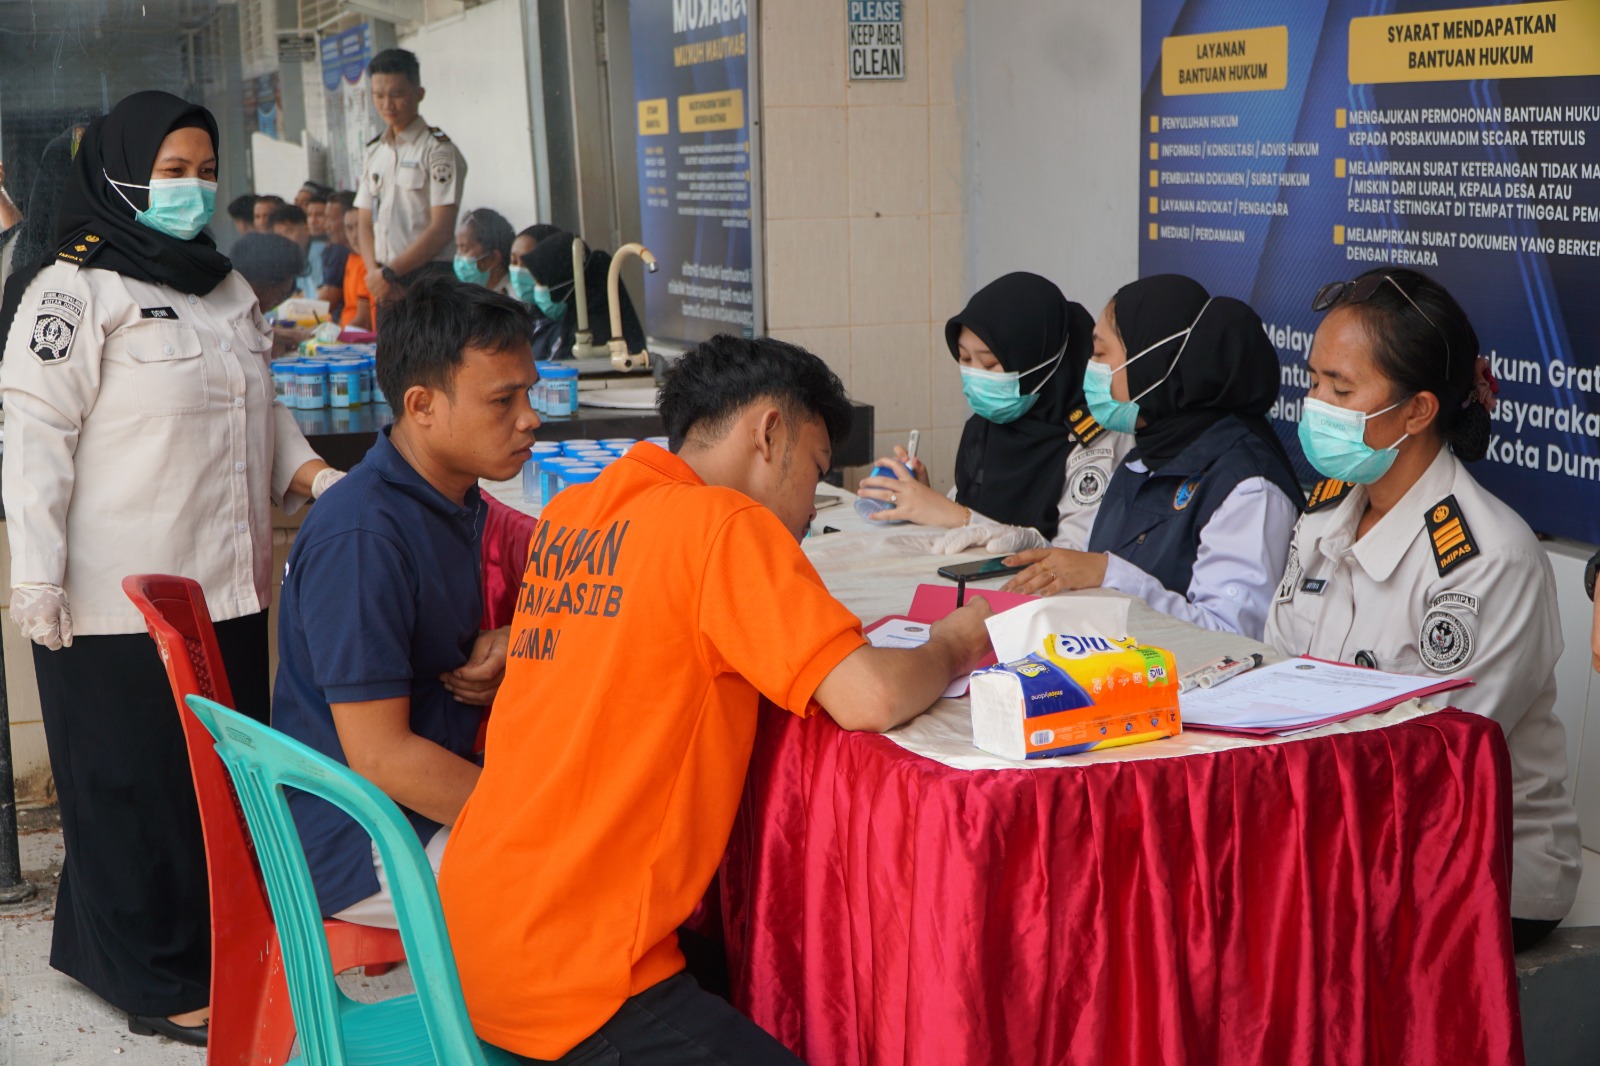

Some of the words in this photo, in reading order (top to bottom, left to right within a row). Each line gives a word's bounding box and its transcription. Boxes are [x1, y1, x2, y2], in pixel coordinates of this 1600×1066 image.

[850, 1, 901, 21] PLEASE
[850, 24, 875, 46] KEEP
[877, 22, 902, 45] AREA
[1387, 22, 1440, 43] SYARAT
[1443, 13, 1557, 40] MENDAPATKAN
[1196, 40, 1246, 59] LAYANAN
[1408, 48, 1476, 69] BANTUAN
[1479, 45, 1534, 66] HUKUM
[852, 49, 901, 76] CLEAN
[1178, 66, 1226, 84] BANTUAN
[1229, 63, 1268, 81] HUKUM
[1162, 116, 1209, 130] PENYULUHAN
[1210, 115, 1239, 129] HUKUM
[1349, 109, 1419, 125] MENGAJUKAN
[1421, 107, 1500, 124] PERMOHONAN
[1504, 106, 1562, 123] BANTUAN
[1349, 131, 1388, 146] KEPADA
[1390, 131, 1479, 146] POSBAKUMADIM
[1482, 130, 1528, 146] SECARA
[1531, 130, 1586, 146] TERTULIS
[1161, 144, 1200, 157] INFORMASI
[1207, 144, 1254, 157] KONSULTASI
[1261, 144, 1286, 156] ADVIS
[1287, 143, 1319, 156] HUKUM
[1161, 172, 1205, 185] PEMBUATAN
[1206, 172, 1245, 186] DOKUMEN
[1251, 173, 1278, 187] SURAT
[1279, 173, 1310, 187] HUKUM
[1348, 161, 1420, 176] MELAMPIRKAN
[1423, 162, 1458, 177] SURAT
[1461, 162, 1538, 178] KETERANGAN
[1541, 163, 1578, 179] TIDAK
[1354, 180, 1389, 194] MISKIN
[1392, 181, 1416, 195] DARI
[1418, 181, 1457, 199] LURAH,
[1459, 182, 1502, 198] KEPALA
[1505, 183, 1536, 199] DESA
[1538, 183, 1572, 200] ATAU
[1161, 199, 1195, 212] LAYANAN
[1196, 200, 1233, 214] ADVOKAT
[1239, 202, 1289, 216] PENGACARA
[1348, 198, 1391, 213] PEJABAT
[1393, 200, 1452, 216] SETINGKAT
[1454, 202, 1466, 217] DI
[1468, 202, 1514, 219] TEMPAT
[1516, 204, 1570, 221] TINGGAL
[1572, 206, 1600, 223] PEM
[1160, 225, 1190, 240] MEDIASI
[1195, 228, 1245, 243] PERDAMAIAN
[1347, 228, 1419, 246] MELAMPIRKAN
[1422, 231, 1457, 248] SURAT
[1459, 233, 1518, 252] DOKUMEN
[1520, 236, 1555, 254] YANG
[1346, 246, 1389, 262] DENGAN
[1391, 248, 1439, 266] PERKARA
[1487, 433, 1540, 470] Kota
[1439, 543, 1472, 568] IMIPAS
